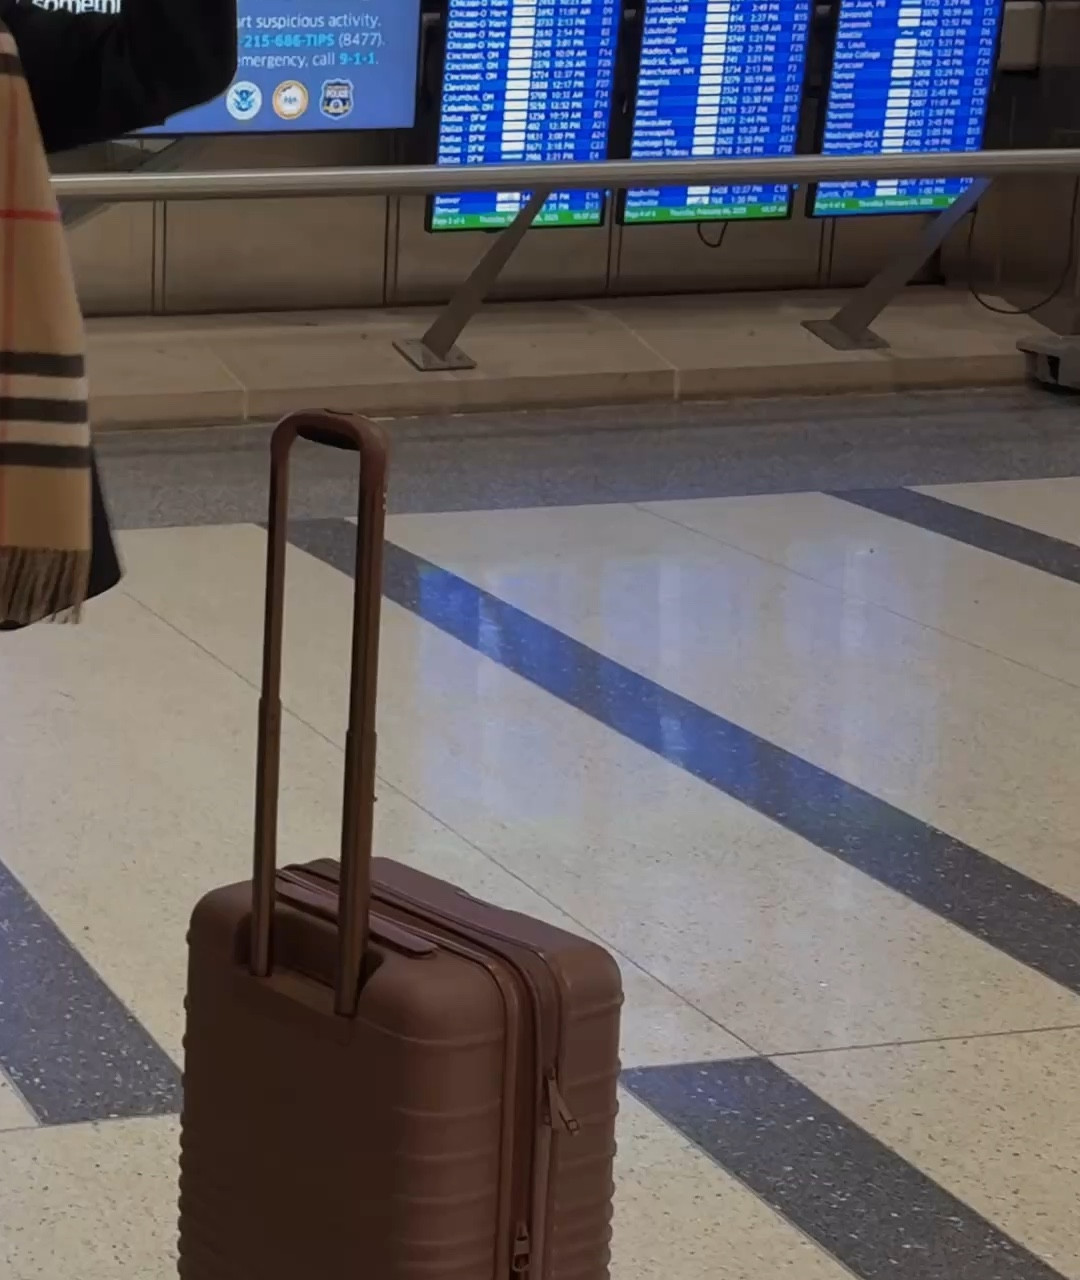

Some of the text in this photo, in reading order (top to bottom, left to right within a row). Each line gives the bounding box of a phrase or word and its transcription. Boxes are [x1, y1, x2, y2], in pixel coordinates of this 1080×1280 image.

[257, 14, 324, 29] suspicious
[328, 14, 381, 28] activity.
[312, 53, 335, 66] call
